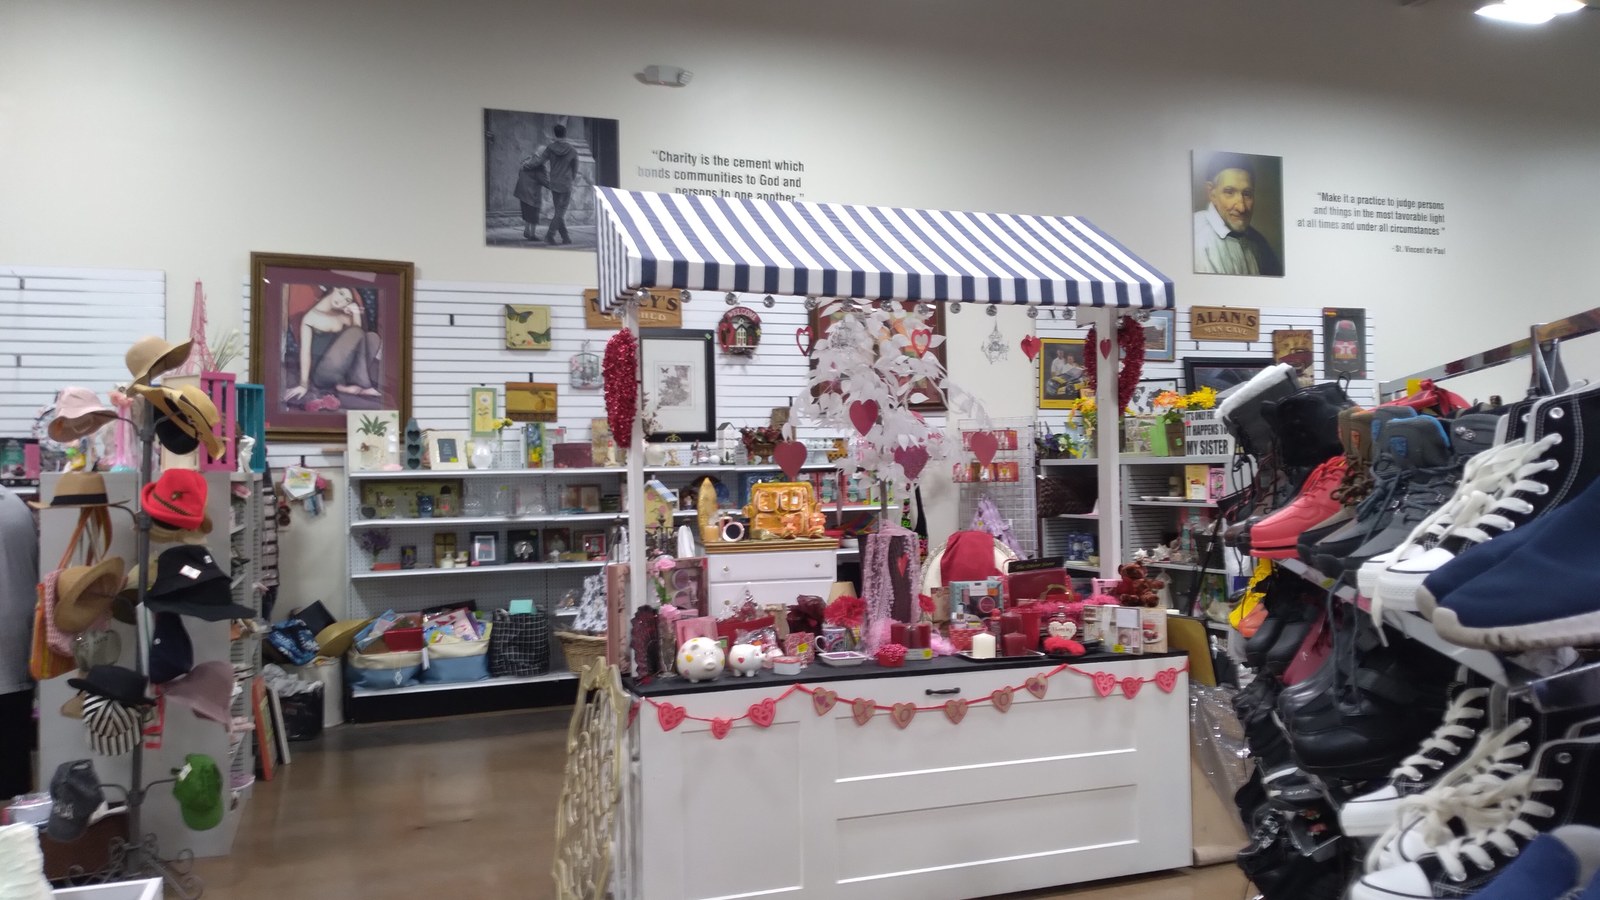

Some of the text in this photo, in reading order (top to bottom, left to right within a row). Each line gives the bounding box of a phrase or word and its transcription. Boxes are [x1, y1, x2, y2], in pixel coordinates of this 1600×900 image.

[701, 154, 710, 166] is
[713, 155, 730, 167] the
[733, 158, 771, 170] cement
[774, 160, 804, 172] which
[638, 166, 801, 188] bonds communities to God and
[1343, 194, 1349, 203] it
[1350, 196, 1356, 204] a
[1357, 196, 1386, 206] practice
[1387, 197, 1395, 206] to
[1396, 198, 1416, 209] judge
[1417, 201, 1445, 210] persons
[1313, 206, 1446, 224] and things in the most favorable light
[1297, 219, 1305, 228] at
[1306, 219, 1317, 228] all
[1318, 219, 1340, 229] times
[1341, 221, 1355, 230] and
[1356, 222, 1377, 232] under
[1379, 223, 1389, 233] all
[1195, 311, 1257, 327] ALAN'S
[1193, 424, 1219, 436] HAPPENS
[1186, 440, 1229, 455] MY SISTER
